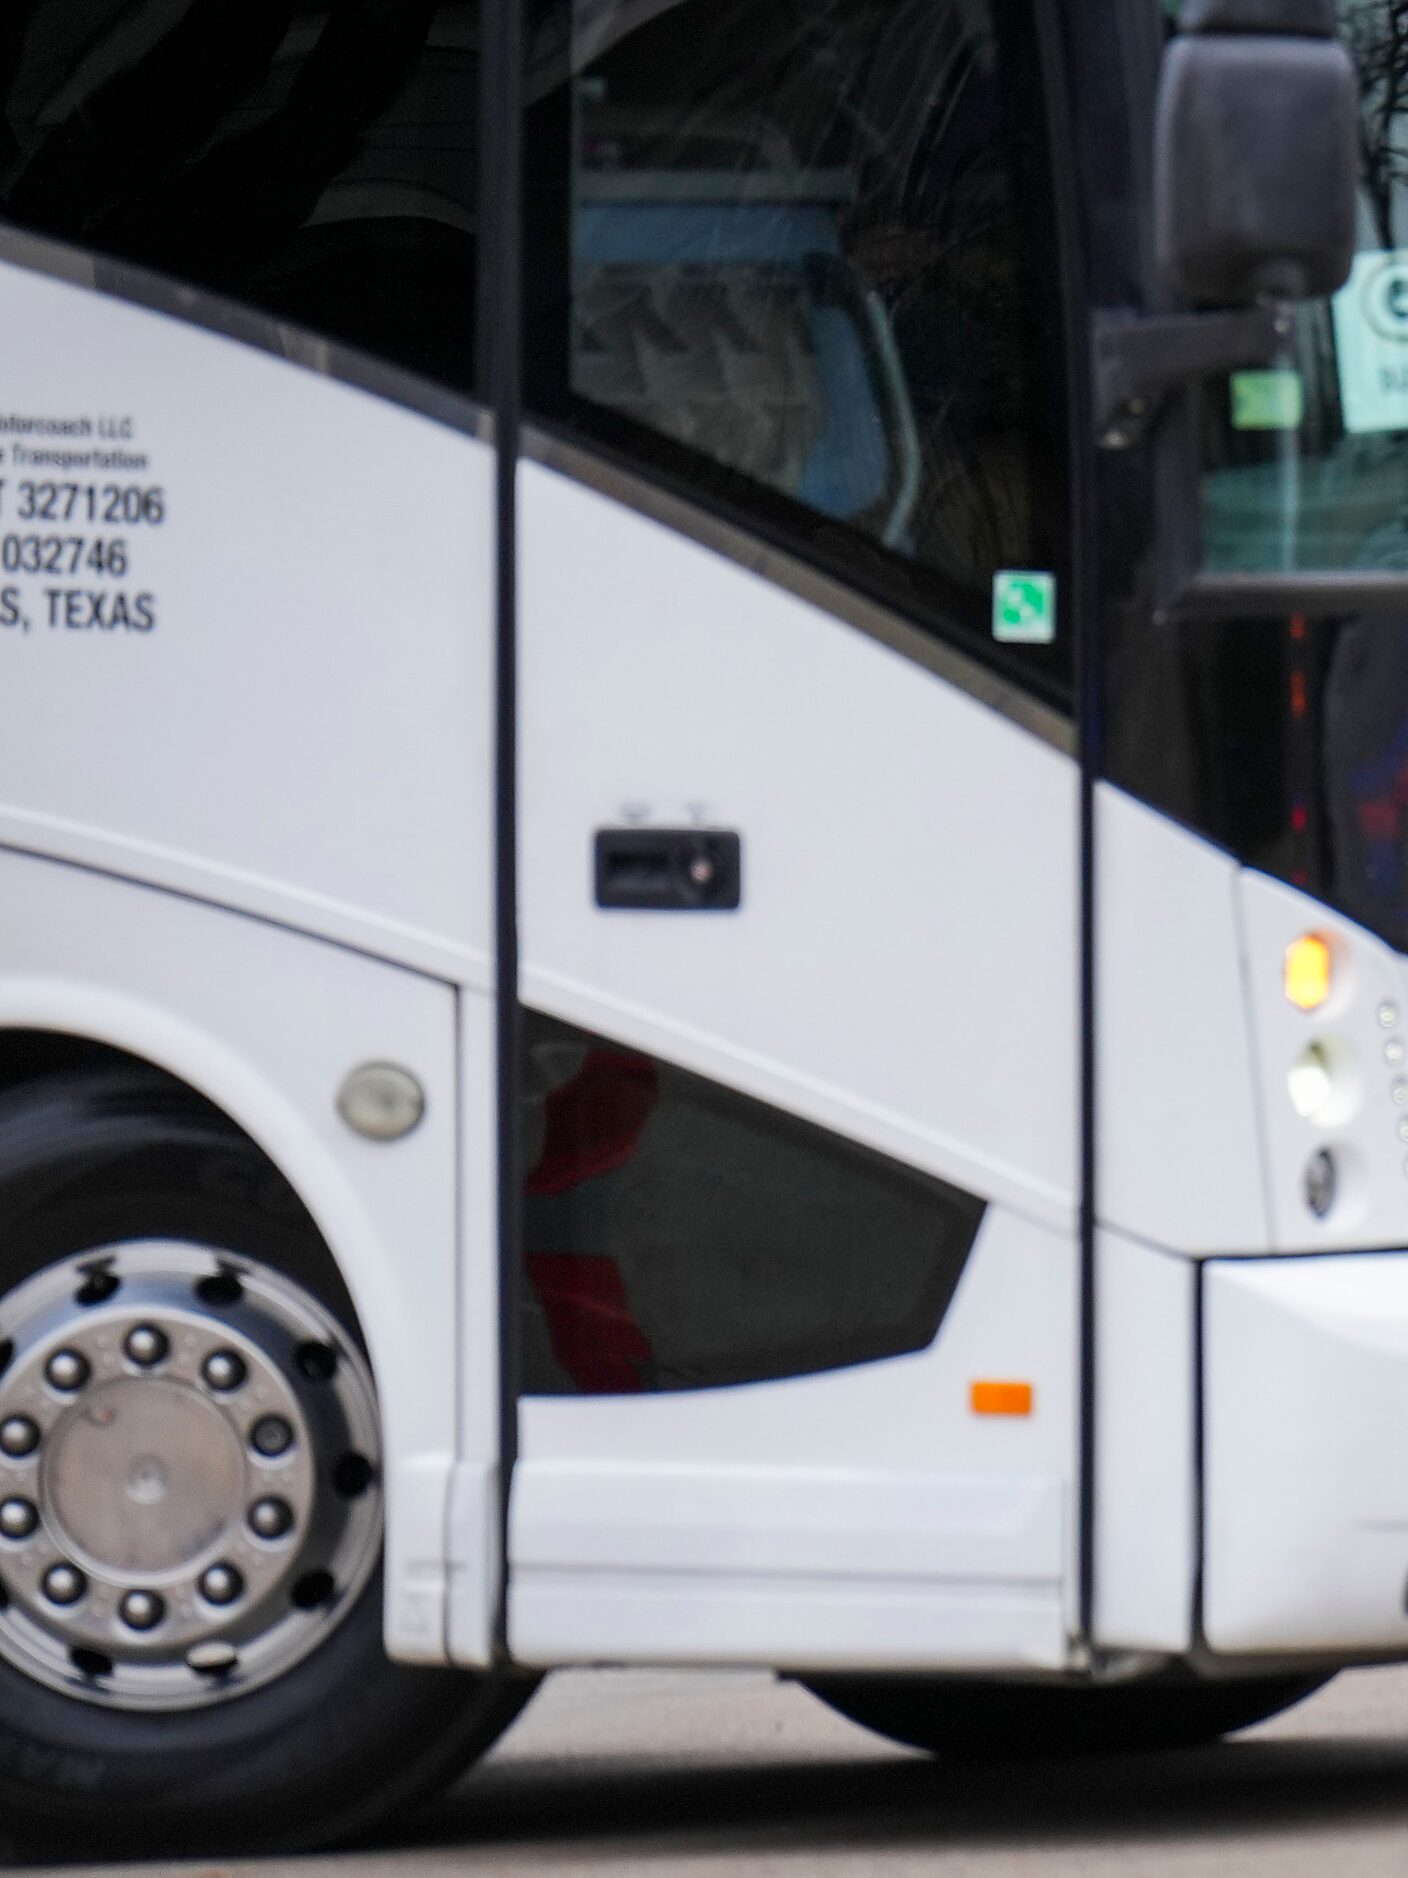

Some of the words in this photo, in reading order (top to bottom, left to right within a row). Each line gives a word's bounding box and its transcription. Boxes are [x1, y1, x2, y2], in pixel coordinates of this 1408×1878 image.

[98, 416, 132, 440] LLC
[18, 481, 164, 526] 3271206
[3, 535, 127, 578] 032746
[44, 589, 154, 632] TEXAS
